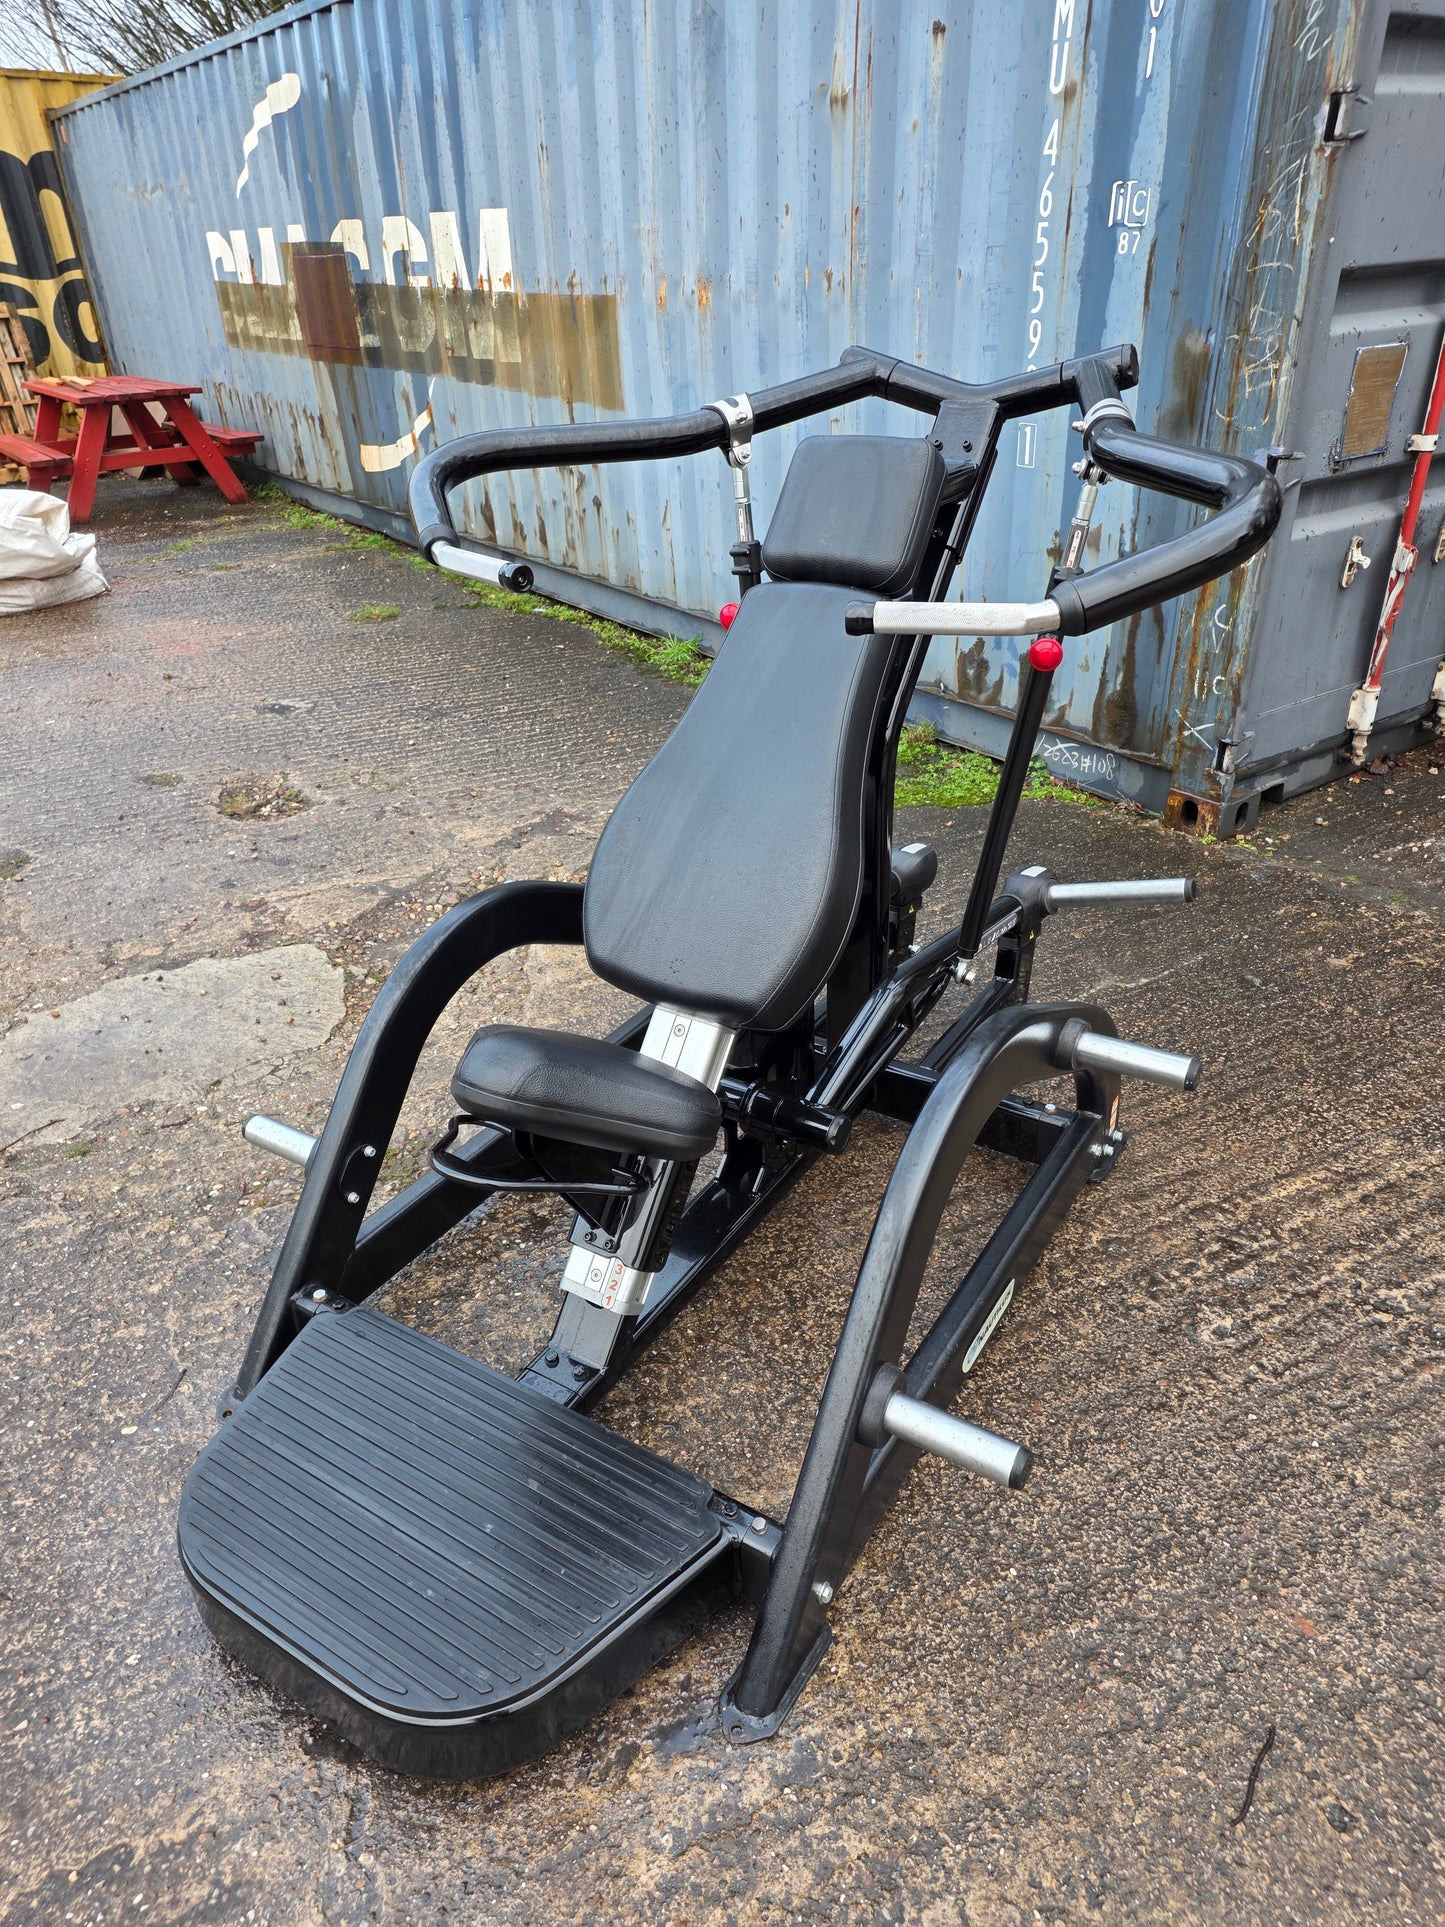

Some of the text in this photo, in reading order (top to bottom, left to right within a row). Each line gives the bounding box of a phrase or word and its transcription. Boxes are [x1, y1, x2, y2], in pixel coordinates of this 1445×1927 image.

[1026, 118, 1060, 373] 46559
[1117, 231, 1141, 255] 87
[1072, 545, 1077, 553] 2
[614, 1263, 624, 1275] 3
[609, 1279, 618, 1291] 2
[605, 1295, 612, 1306] 1
